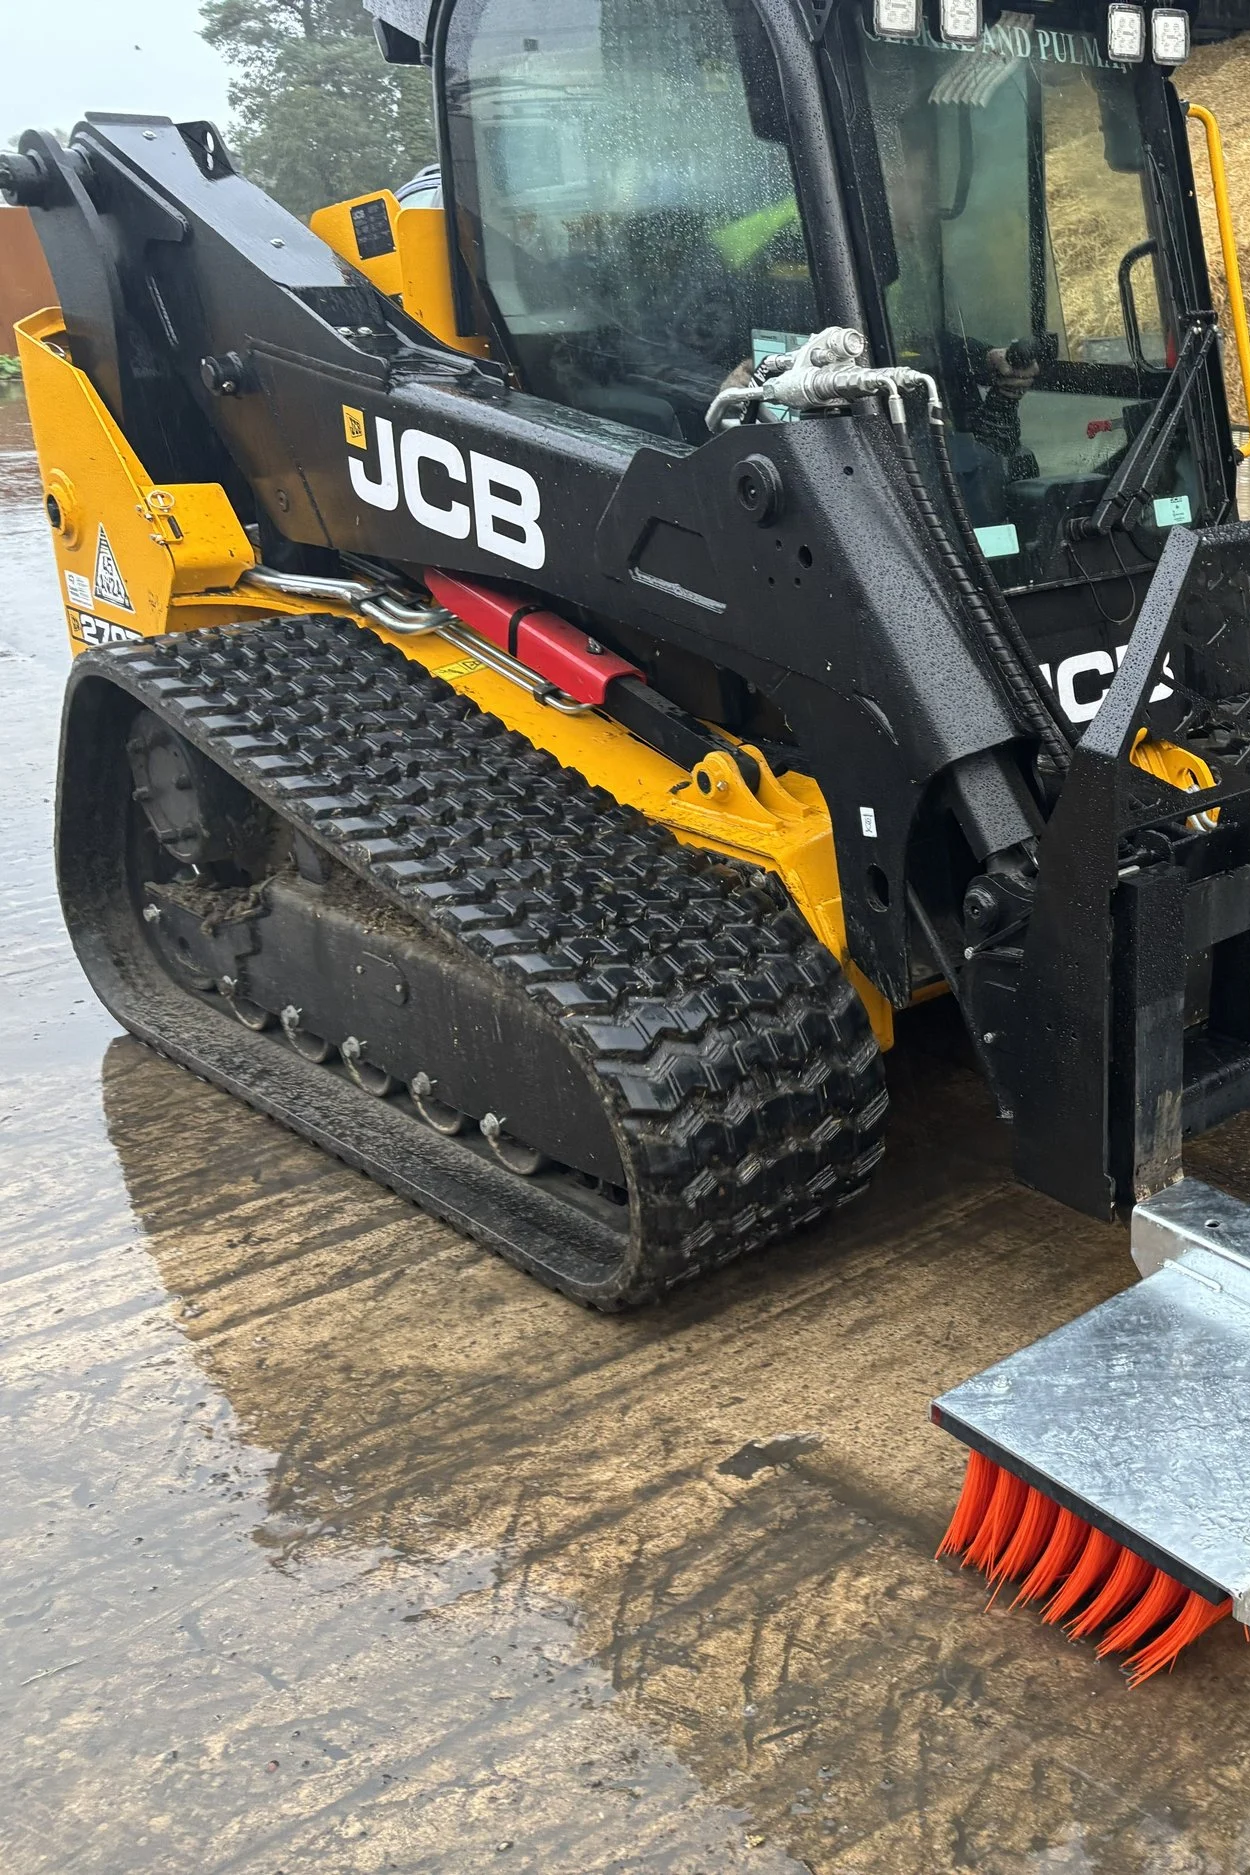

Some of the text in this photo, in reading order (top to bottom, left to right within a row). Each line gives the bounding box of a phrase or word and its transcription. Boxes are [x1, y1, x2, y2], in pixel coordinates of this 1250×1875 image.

[982, 23, 1031, 59] AND
[1035, 30, 1133, 73] PULM
[348, 416, 546, 570] JCB
